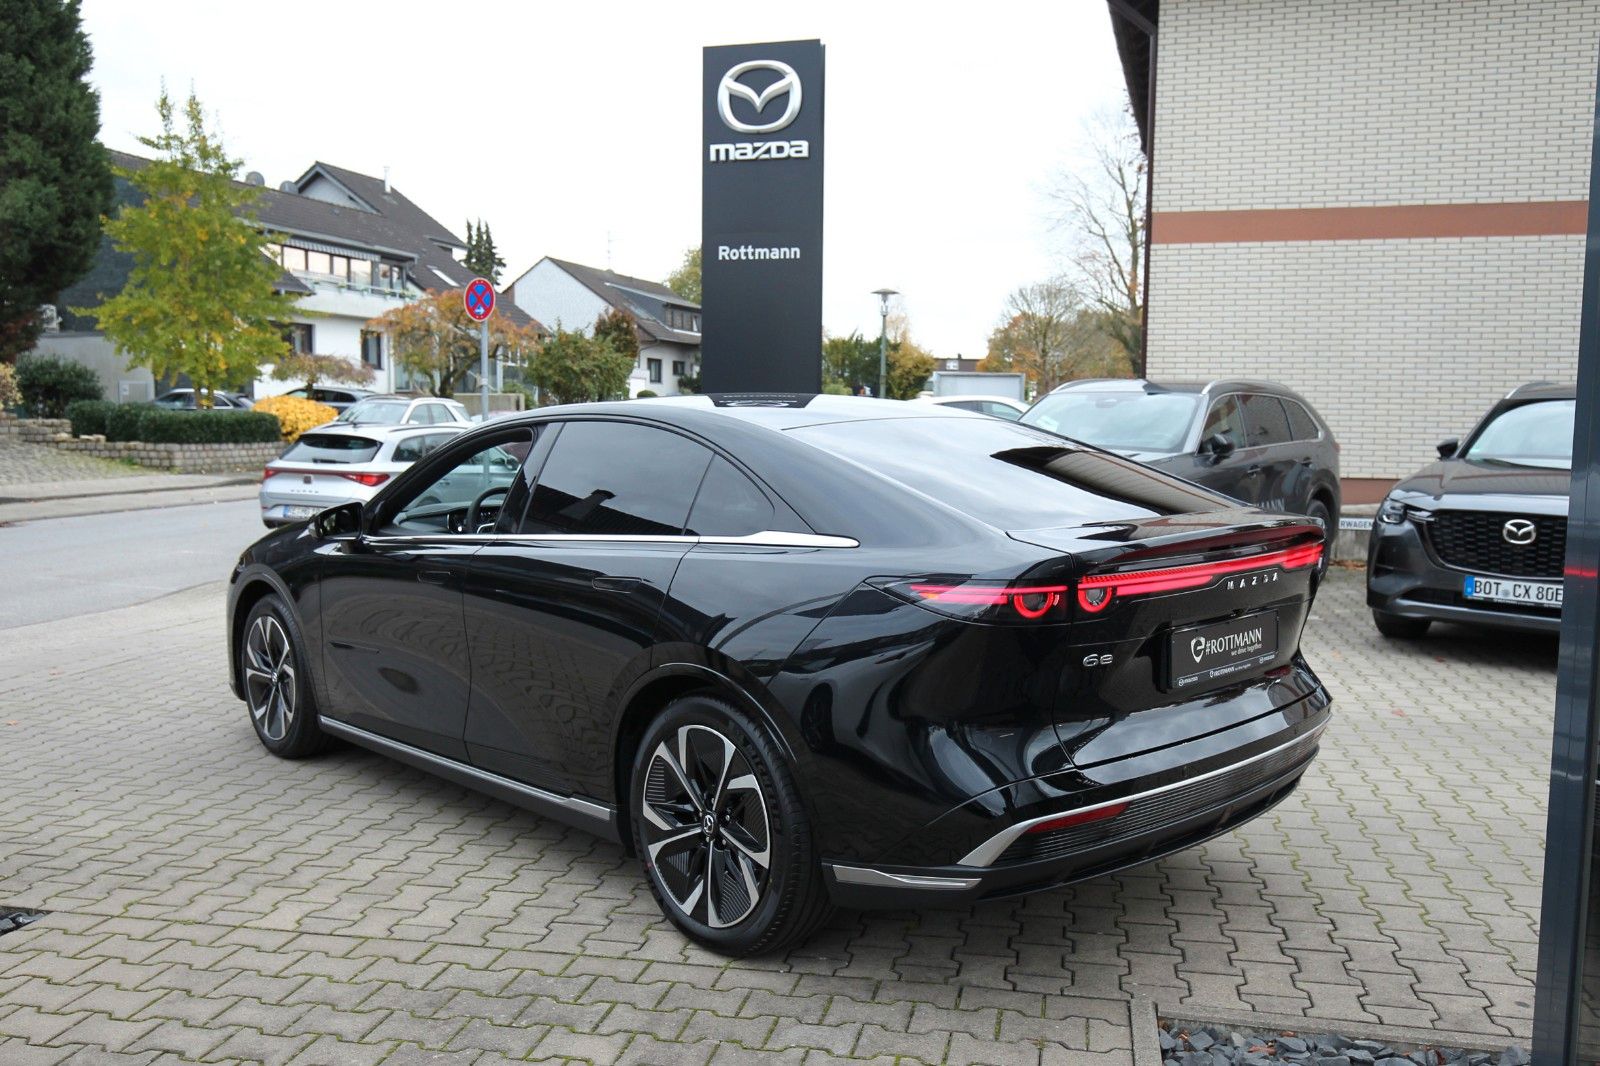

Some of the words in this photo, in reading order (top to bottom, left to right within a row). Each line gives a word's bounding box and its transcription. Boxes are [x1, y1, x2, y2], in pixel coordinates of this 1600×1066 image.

[718, 245, 800, 260] Rottmann
[1227, 572, 1279, 590] MAZDA
[1474, 580, 1502, 596] BOT
[1513, 584, 1532, 599] CX
[1205, 627, 1262, 656] #ROTTMANN
[1083, 653, 1114, 667] 6e
